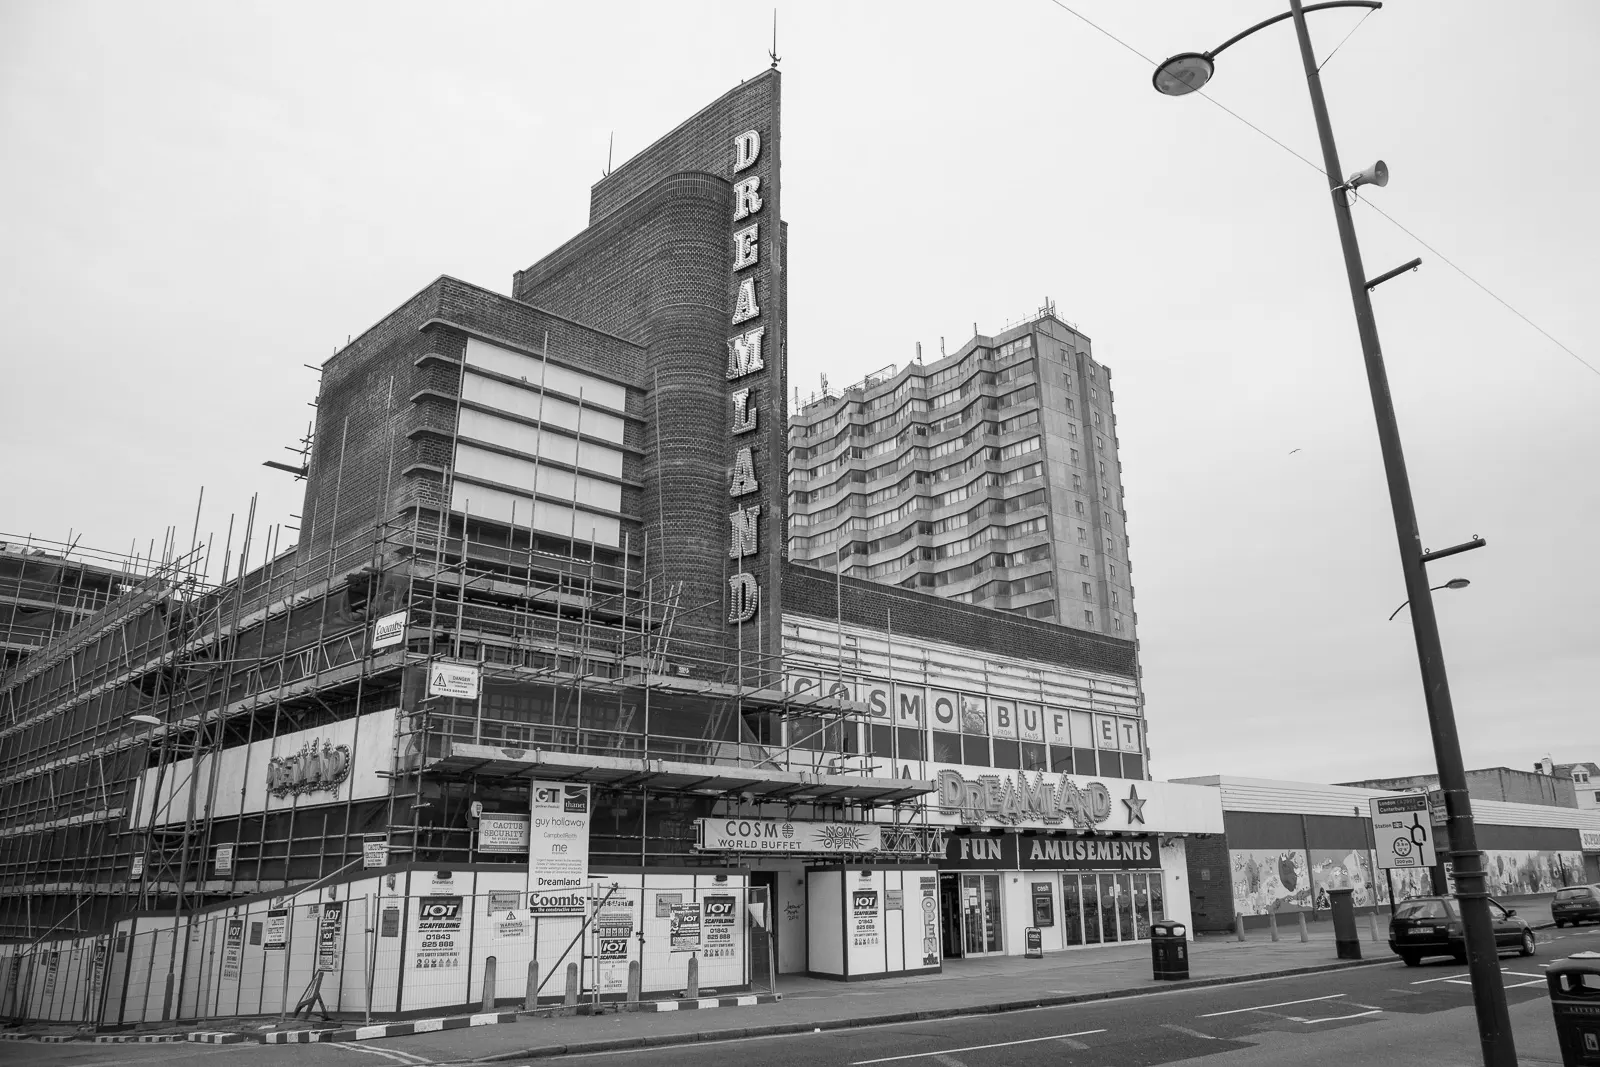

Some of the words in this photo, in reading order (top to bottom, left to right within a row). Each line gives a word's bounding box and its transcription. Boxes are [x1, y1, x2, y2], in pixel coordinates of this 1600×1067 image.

[725, 129, 764, 625] DREAMLAND
[377, 621, 403, 635] Coombs
[536, 788, 560, 803] GT
[938, 768, 1112, 829] DREAMLAND
[565, 801, 586, 809] thanet
[535, 818, 550, 827] guy
[552, 817, 585, 828] holloway
[825, 825, 856, 837] NOW
[552, 844, 568, 852] me
[718, 839, 757, 848] WORLD
[761, 841, 801, 849] BUFFET
[823, 838, 859, 849] OPEN
[960, 838, 1001, 859] FUN
[1030, 839, 1152, 860] AMUSEMENTS
[538, 877, 581, 886] Dreamland
[530, 893, 585, 906] Coombs
[855, 897, 874, 906] IOT
[423, 905, 457, 916] IOT
[706, 904, 731, 913] IOT
[326, 910, 340, 919] IOT
[922, 896, 938, 953] OPEN
[229, 927, 240, 936] IOT
[602, 942, 625, 951] IOT
